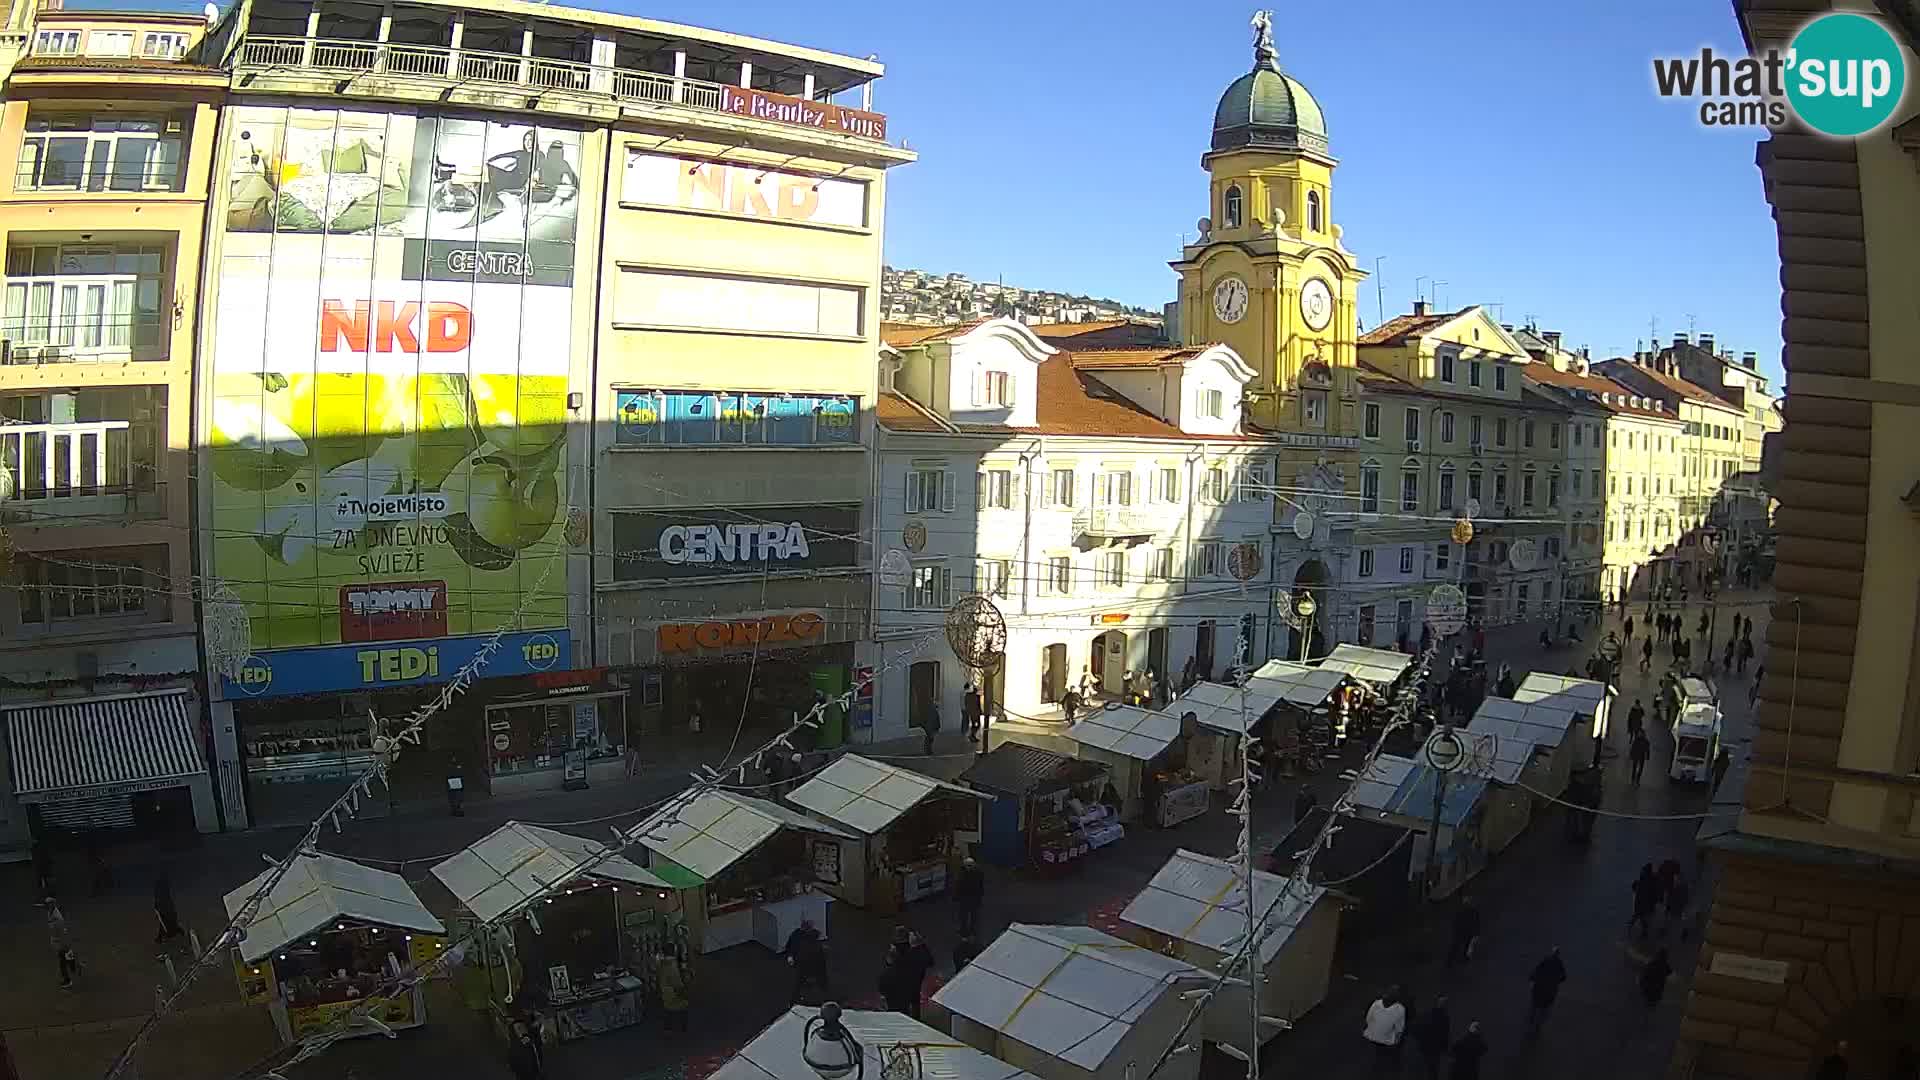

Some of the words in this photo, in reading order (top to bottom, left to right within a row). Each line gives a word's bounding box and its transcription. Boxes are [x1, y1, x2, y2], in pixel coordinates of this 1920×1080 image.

[721, 87, 745, 114] Le
[682, 159, 819, 218] NKD
[447, 249, 534, 276] CENTRA
[320, 299, 475, 353] NKD
[337, 497, 446, 516] #TvojeMisto
[333, 529, 356, 549] ZA
[367, 525, 449, 548] DNEVNO
[659, 522, 810, 564] CENTRA
[358, 548, 425, 576] SVJEŽE
[348, 588, 437, 614] TOMMY
[357, 646, 439, 683] TEDi
[522, 644, 558, 662] TEDi
